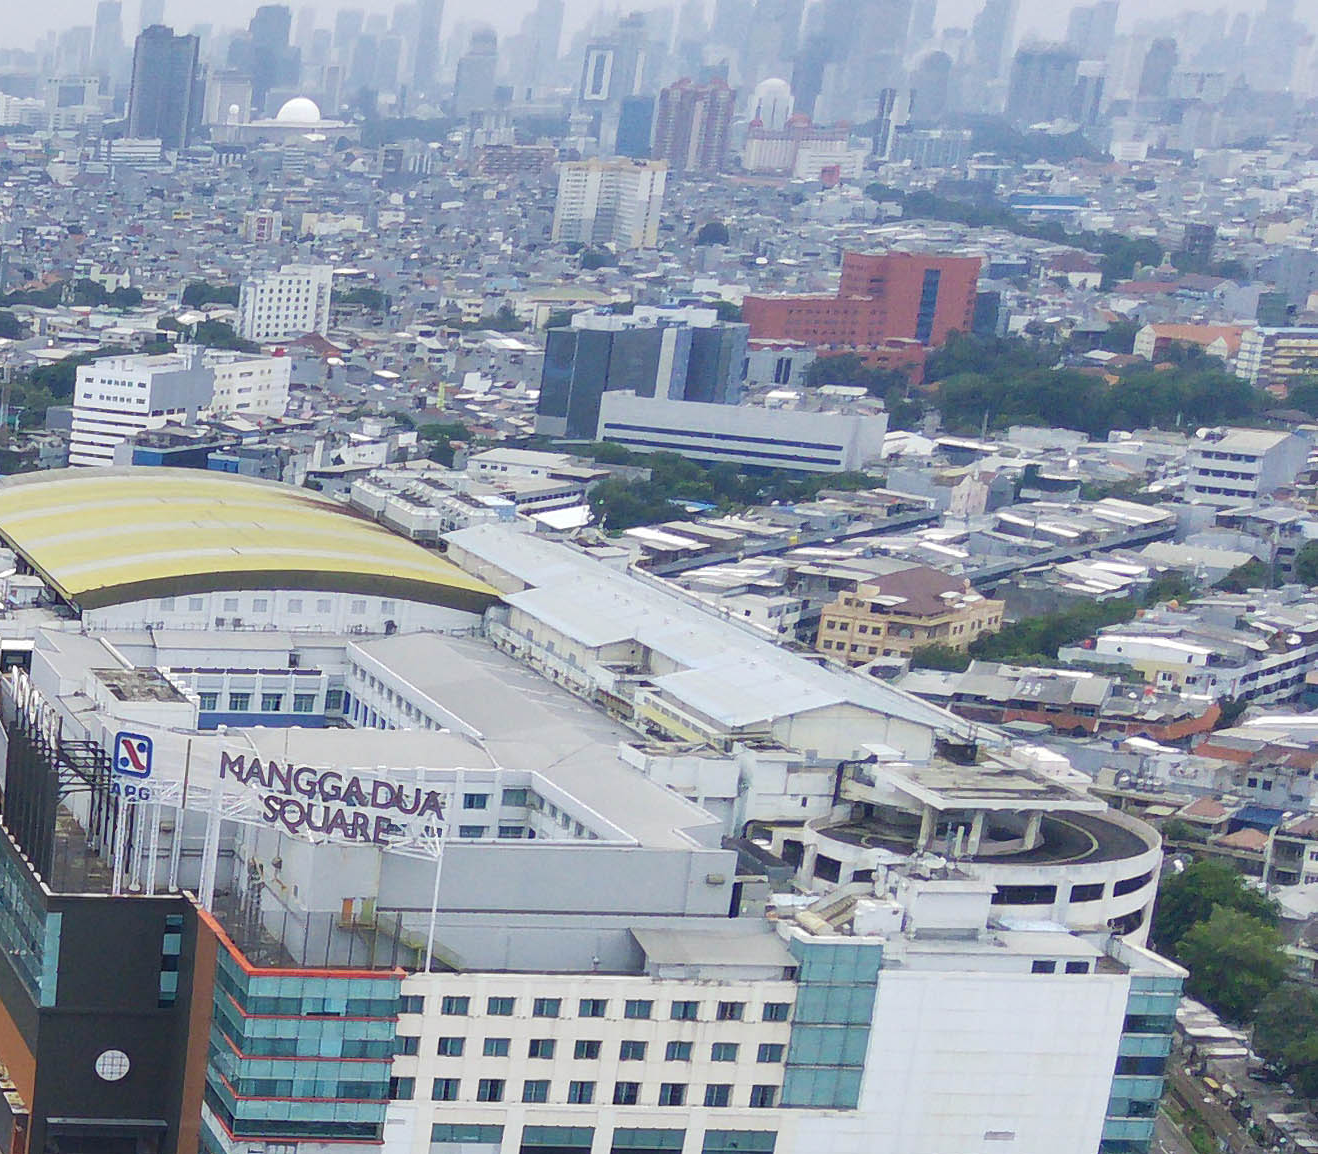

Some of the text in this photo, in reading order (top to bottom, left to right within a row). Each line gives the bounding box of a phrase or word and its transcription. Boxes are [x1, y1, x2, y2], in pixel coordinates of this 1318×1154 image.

[219, 751, 445, 821] MANGGA DUA
[260, 795, 392, 845] SQUARE
